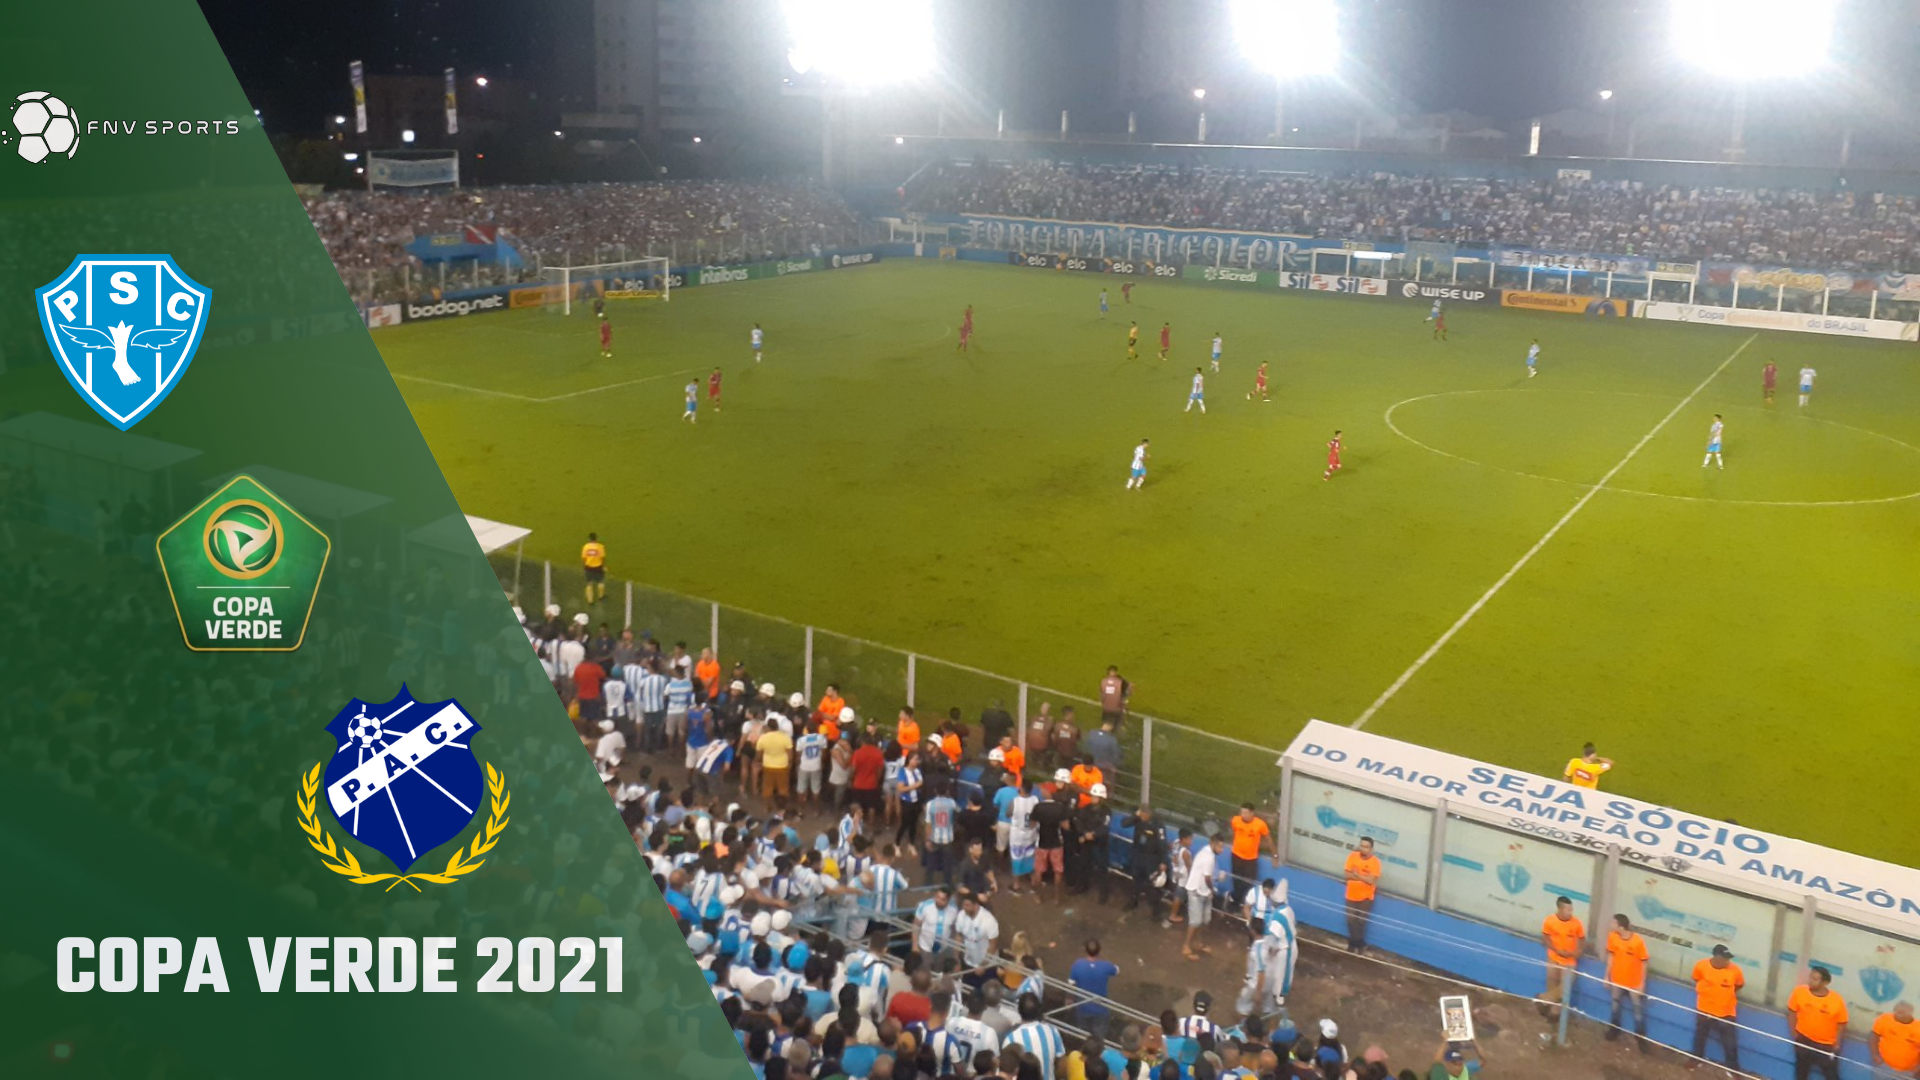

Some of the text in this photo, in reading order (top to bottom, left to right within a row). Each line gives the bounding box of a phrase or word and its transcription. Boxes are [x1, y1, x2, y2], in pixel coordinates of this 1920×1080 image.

[1218, 269, 1257, 283] Sicredi
[1421, 287, 1485, 300] WISE UP
[408, 295, 503, 318] bodog.net
[1301, 743, 1348, 763] DO
[1356, 758, 1468, 796] MAIOR
[1479, 790, 1661, 847] CAMPEÃO
[1674, 840, 1726, 866] DA
[1467, 767, 1770, 854] SEJA SÓCIO
